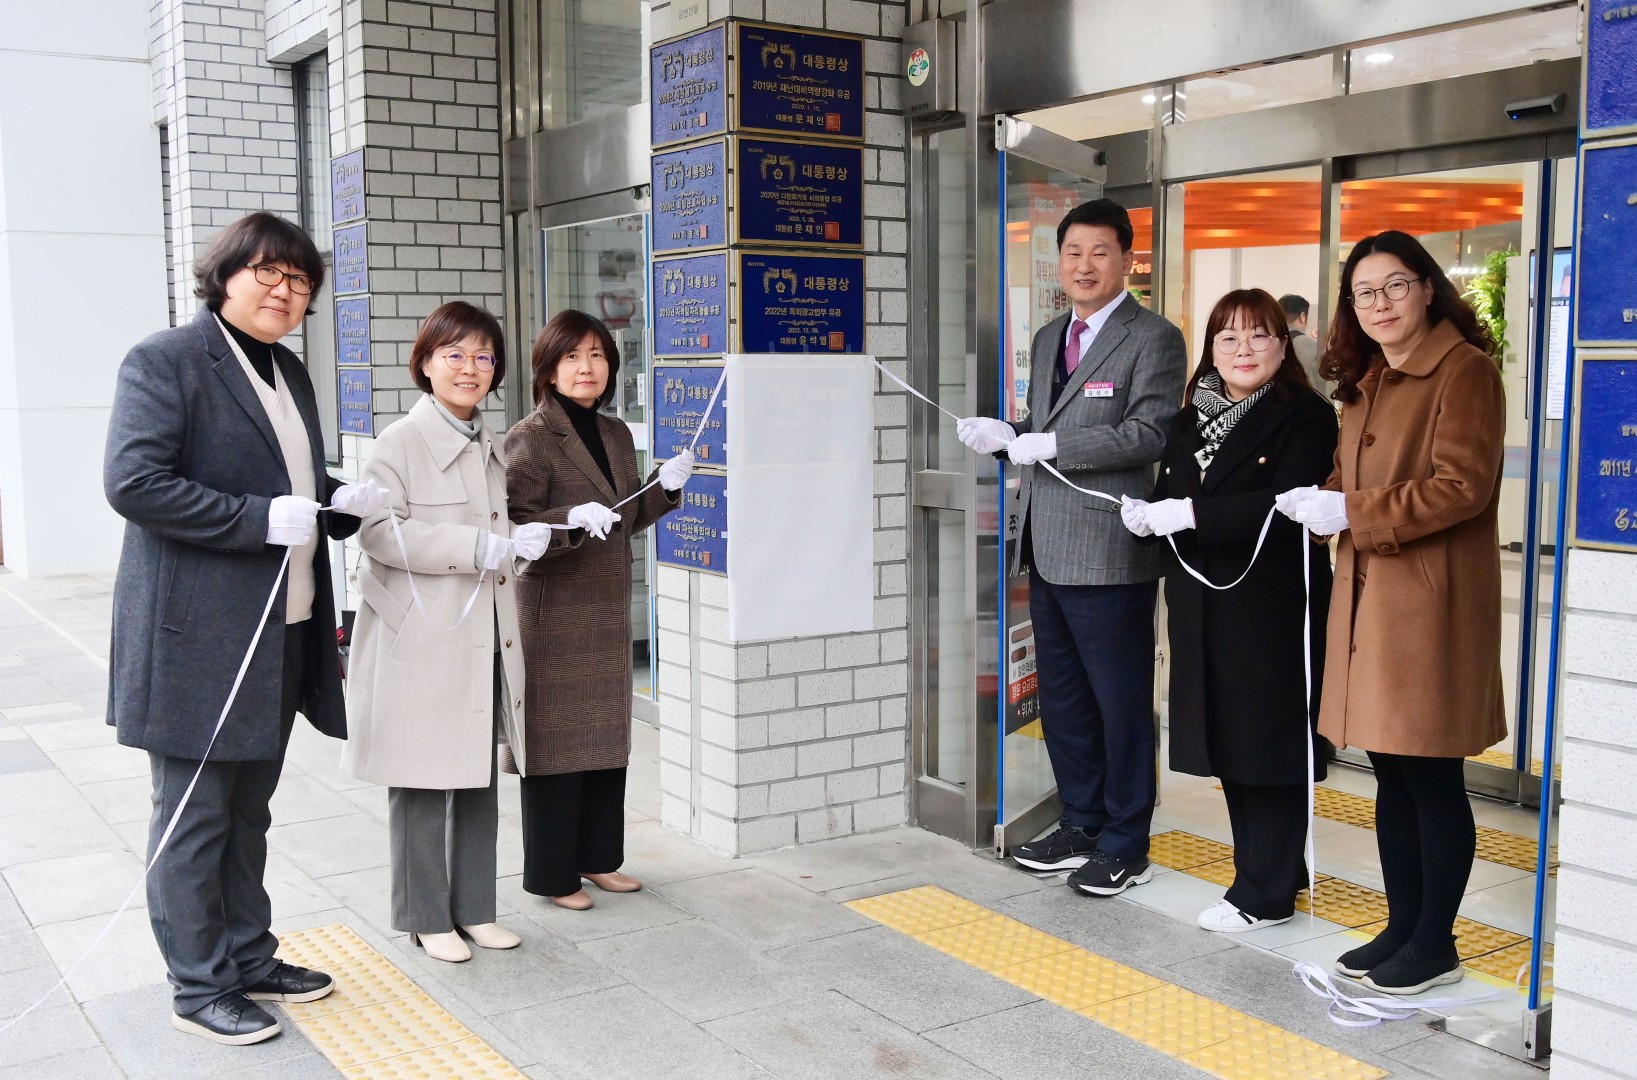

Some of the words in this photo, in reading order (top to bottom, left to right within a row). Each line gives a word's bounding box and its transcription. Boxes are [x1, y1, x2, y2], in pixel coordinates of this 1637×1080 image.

[686, 48, 714, 68] 대통령상
[803, 54, 848, 72] 대통령상
[752, 80, 778, 92] 2019년
[780, 84, 834, 98] 재난대비역량강화
[837, 89, 850, 100] 유공
[686, 162, 714, 179] 대통령상
[802, 164, 848, 180] 대통령상
[687, 274, 717, 288] 대통령상
[804, 276, 850, 292] 대통령상
[764, 306, 787, 316] 2022년
[828, 308, 842, 317] 유공
[1600, 459, 1632, 477] 2011년
[687, 492, 716, 508] 대통령상
